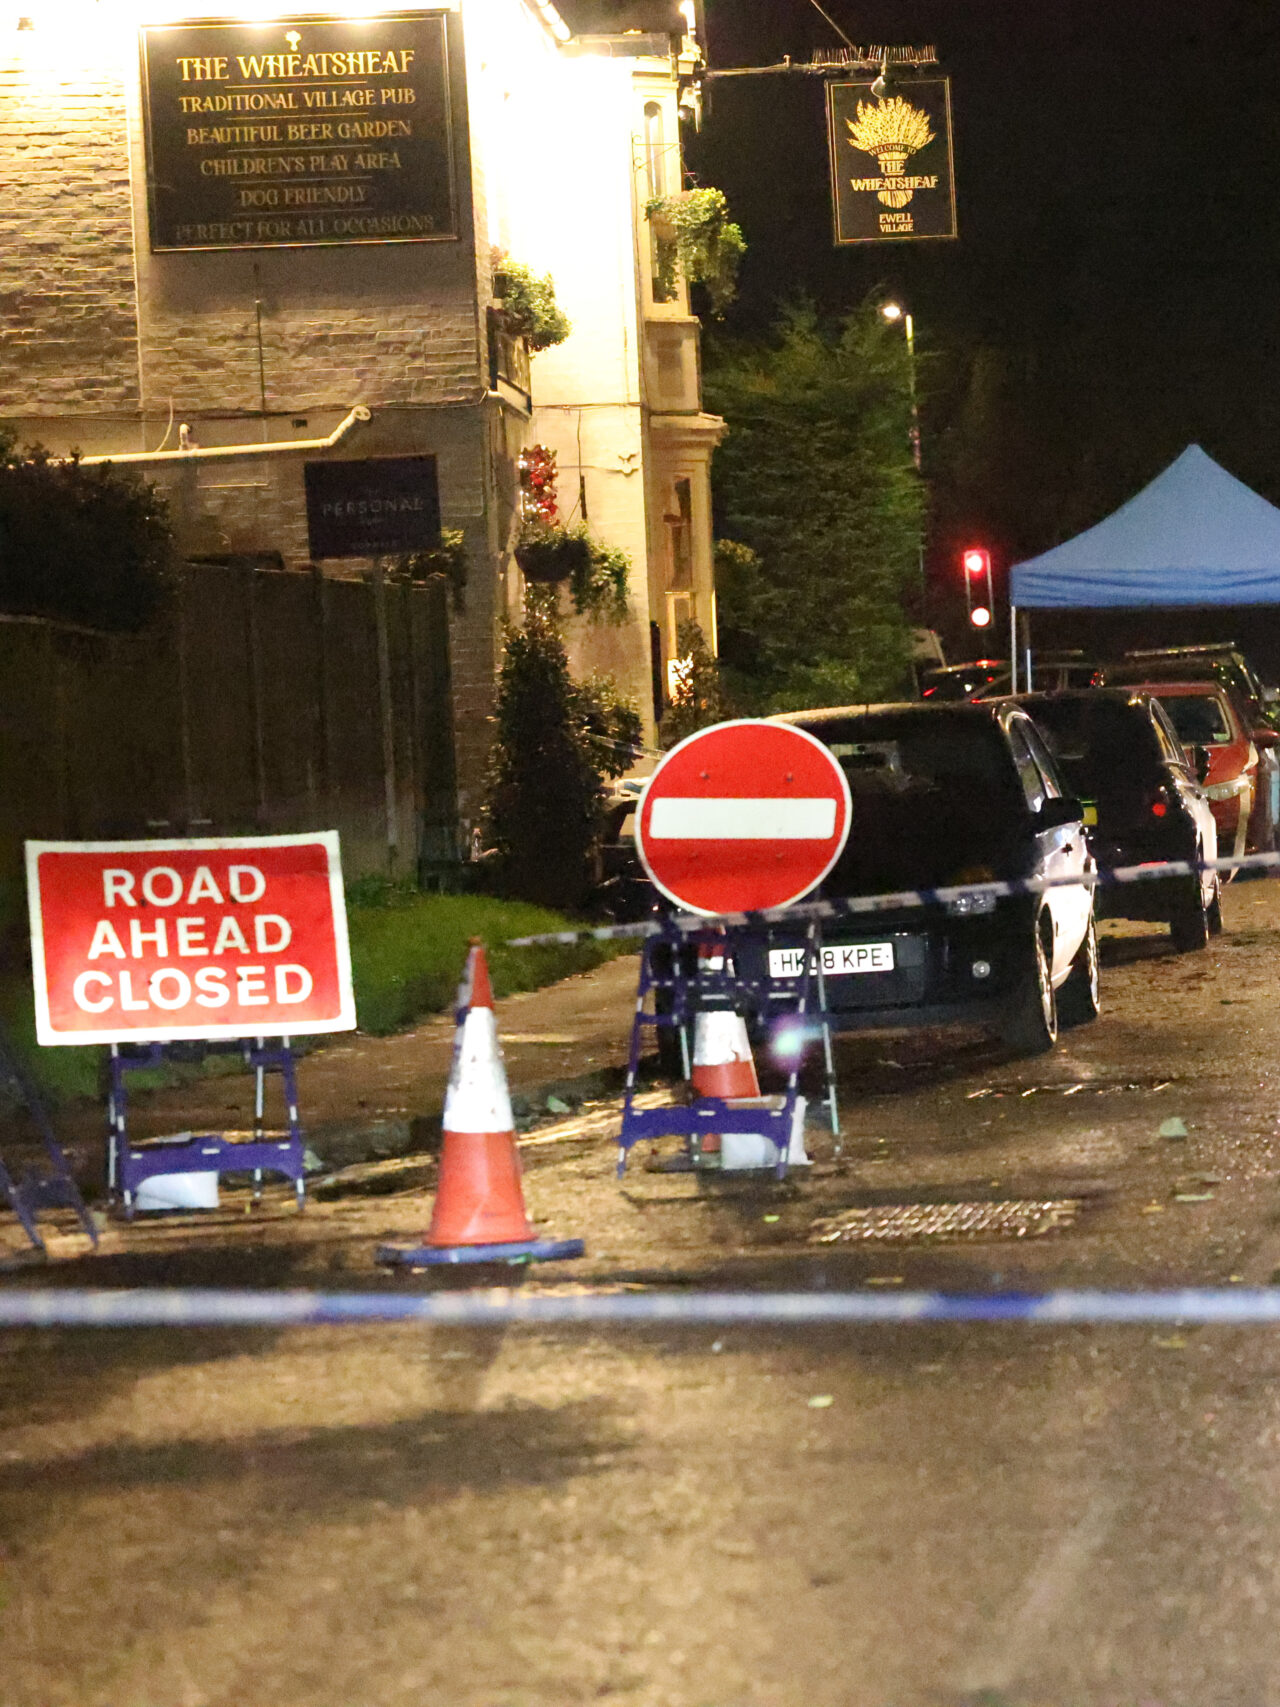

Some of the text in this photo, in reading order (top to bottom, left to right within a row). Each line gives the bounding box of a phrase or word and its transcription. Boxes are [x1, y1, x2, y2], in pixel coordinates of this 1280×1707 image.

[175, 50, 415, 81] THE WHEATSHEAF
[178, 87, 417, 113] TRADITIONAL VILLAGE PUB
[186, 119, 412, 145] BEAUTIFUL BEER GARDEN
[868, 144, 917, 157] WELCOME TO
[200, 151, 402, 176] CHILDREN'S PLAY AREA
[877, 160, 906, 174] THE
[850, 175, 939, 192] WHEATSHEAF
[240, 185, 369, 207] DOG FRIENDLY
[175, 214, 435, 241] PERFECT FOR ALL OCCASIONS
[879, 212, 914, 224] EWELL
[880, 223, 914, 233] VILLAGE
[321, 497, 425, 518] PERSONAL
[102, 864, 267, 908] ROAD
[87, 913, 293, 960] AHEAD
[842, 947, 884, 969] KPE
[72, 963, 314, 1014] CLOSED
